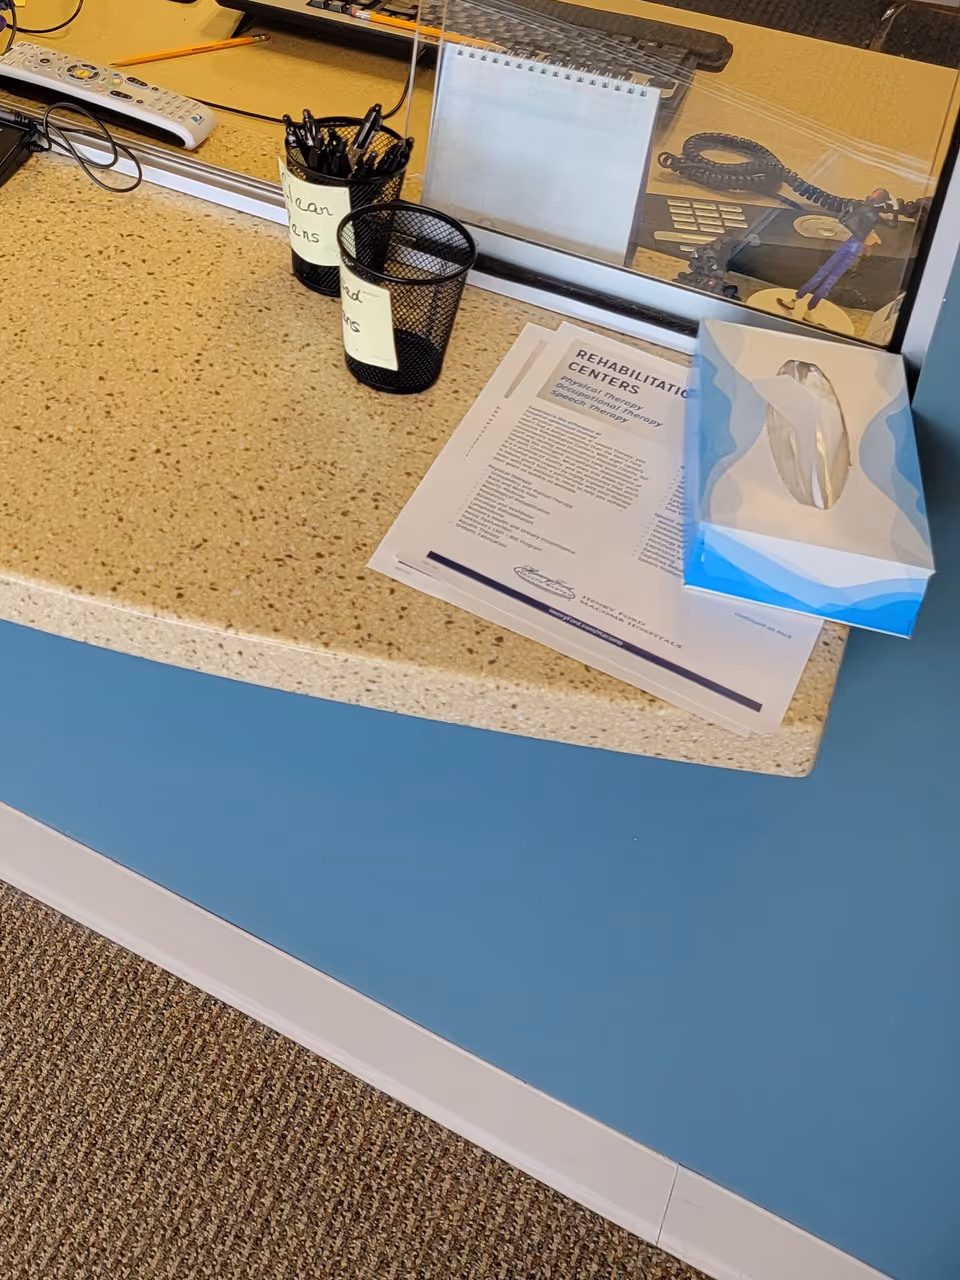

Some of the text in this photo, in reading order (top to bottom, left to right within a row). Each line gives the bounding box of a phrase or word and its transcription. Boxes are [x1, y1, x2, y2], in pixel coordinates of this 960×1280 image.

[291, 223, 320, 243] ens
[560, 376, 644, 411] Physical Therapy
[568, 361, 641, 395] CENTERS
[551, 390, 587, 407] Speech
[588, 404, 629, 424] Therapy
[556, 383, 621, 411] Occupational
[623, 407, 663, 428] Therapy
[627, 622, 683, 649] HOSPITALS
